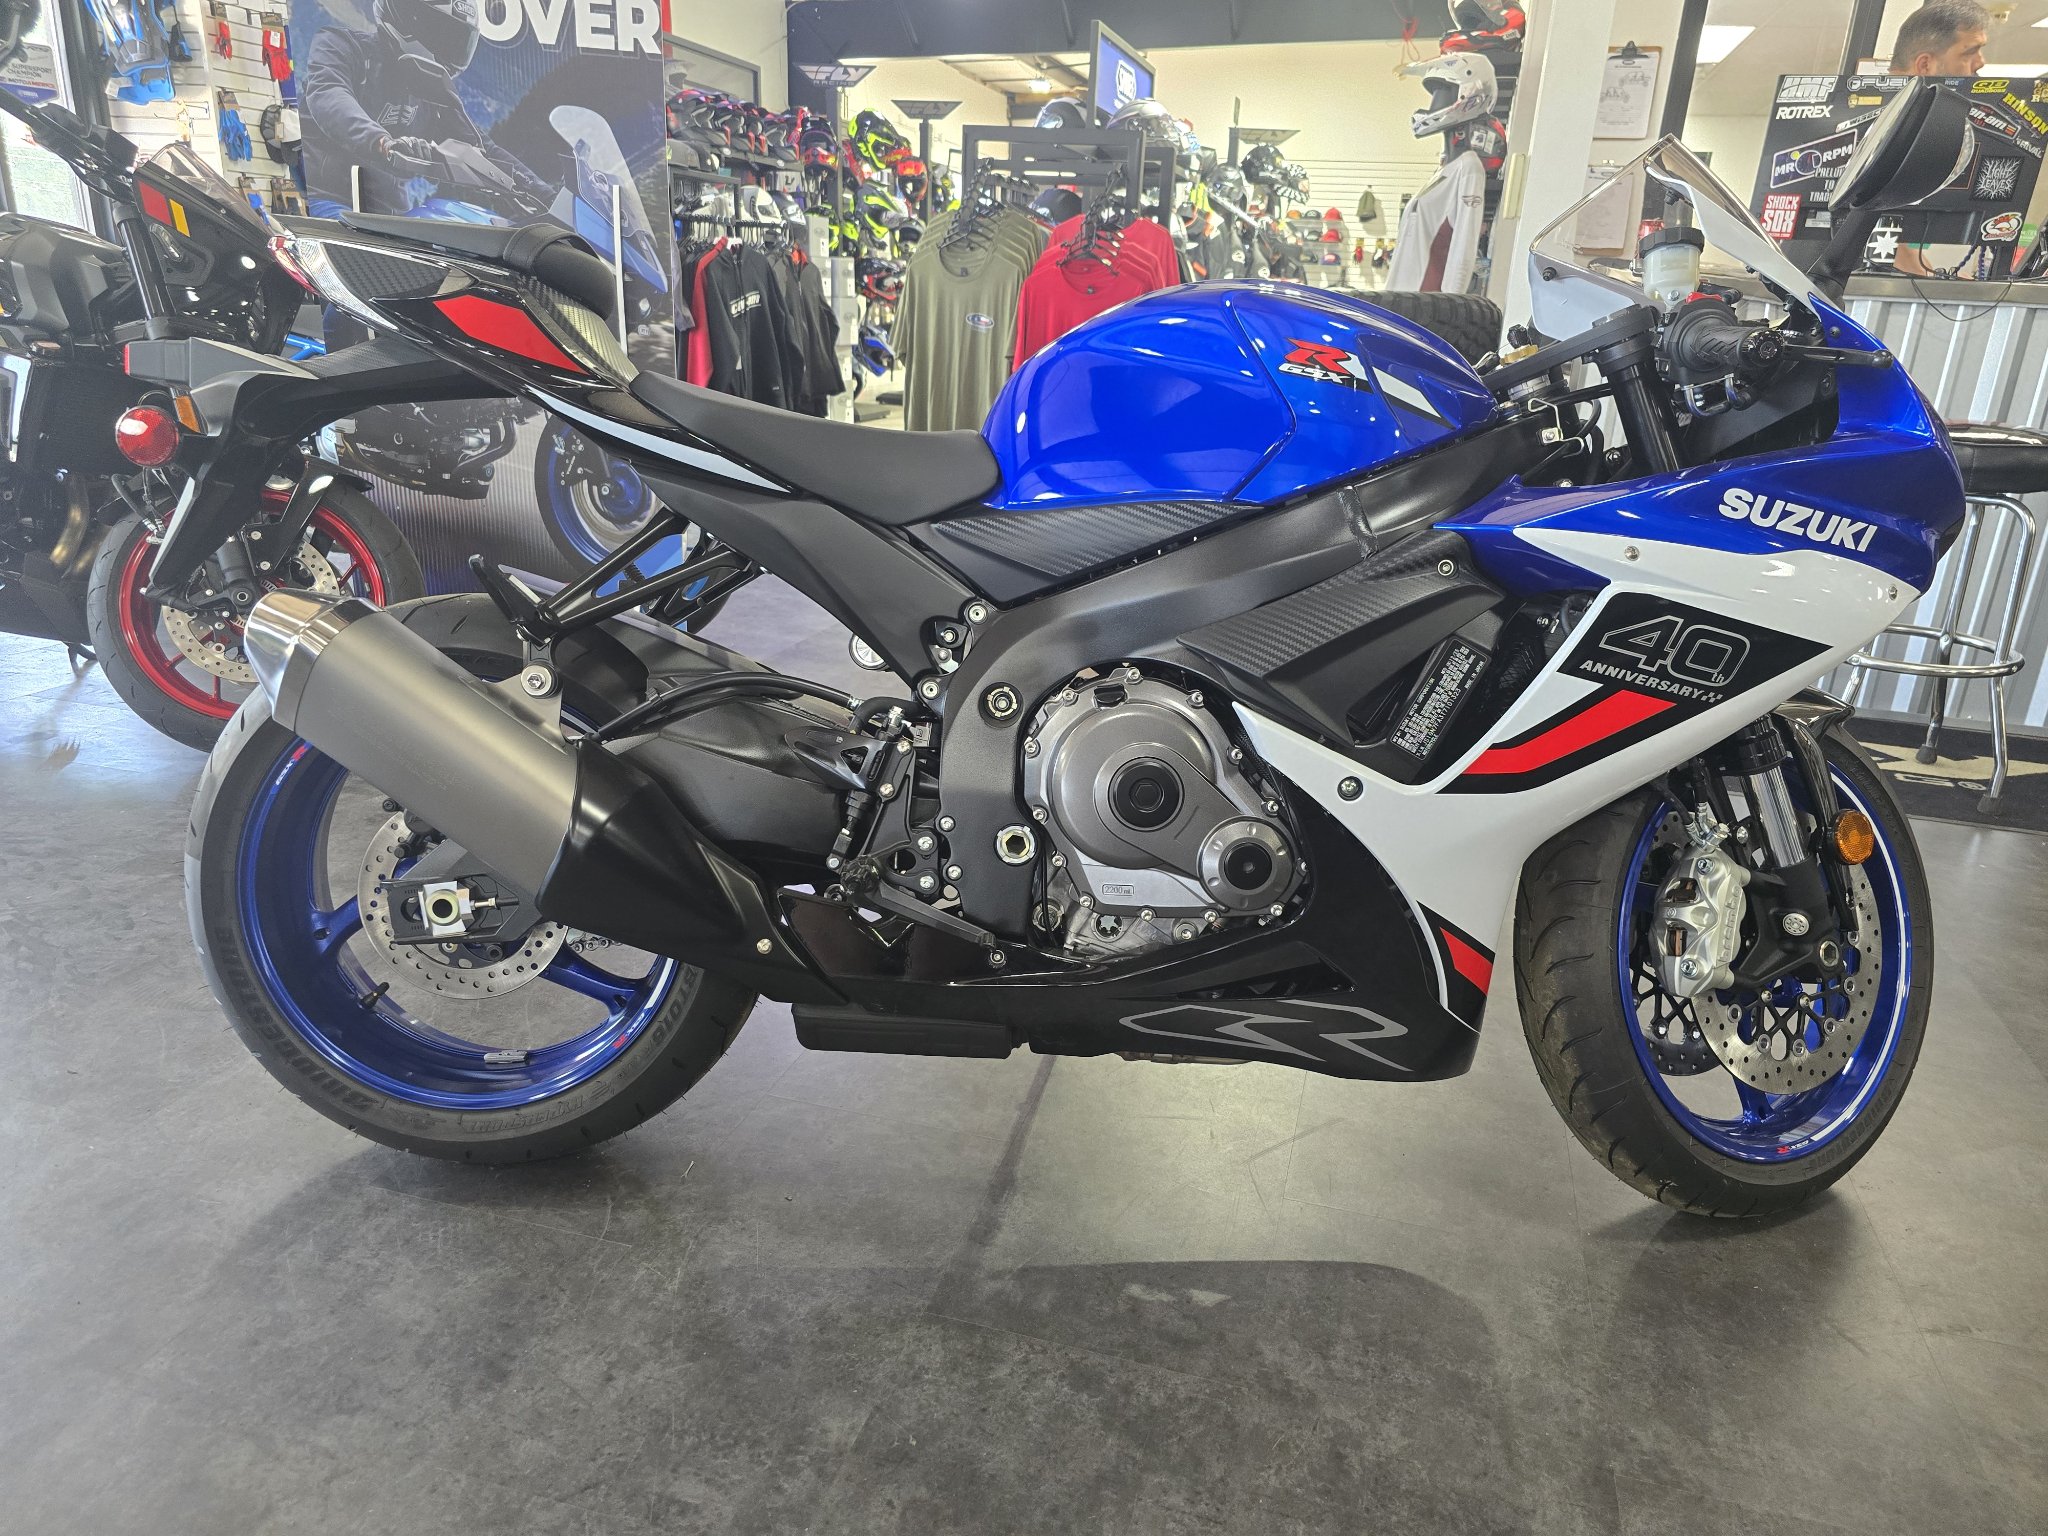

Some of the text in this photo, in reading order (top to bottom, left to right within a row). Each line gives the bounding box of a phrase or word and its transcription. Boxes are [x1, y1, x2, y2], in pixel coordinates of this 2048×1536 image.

[1775, 105, 1833, 119] ROTREX
[1774, 144, 1853, 177] MR RPM
[1765, 195, 1800, 210] SHOCK
[1761, 210, 1797, 233] SOX
[1718, 487, 1878, 552] SUZUKI
[1579, 659, 1706, 700] ANNIVERSARY
[1104, 885, 1123, 894] 2200
